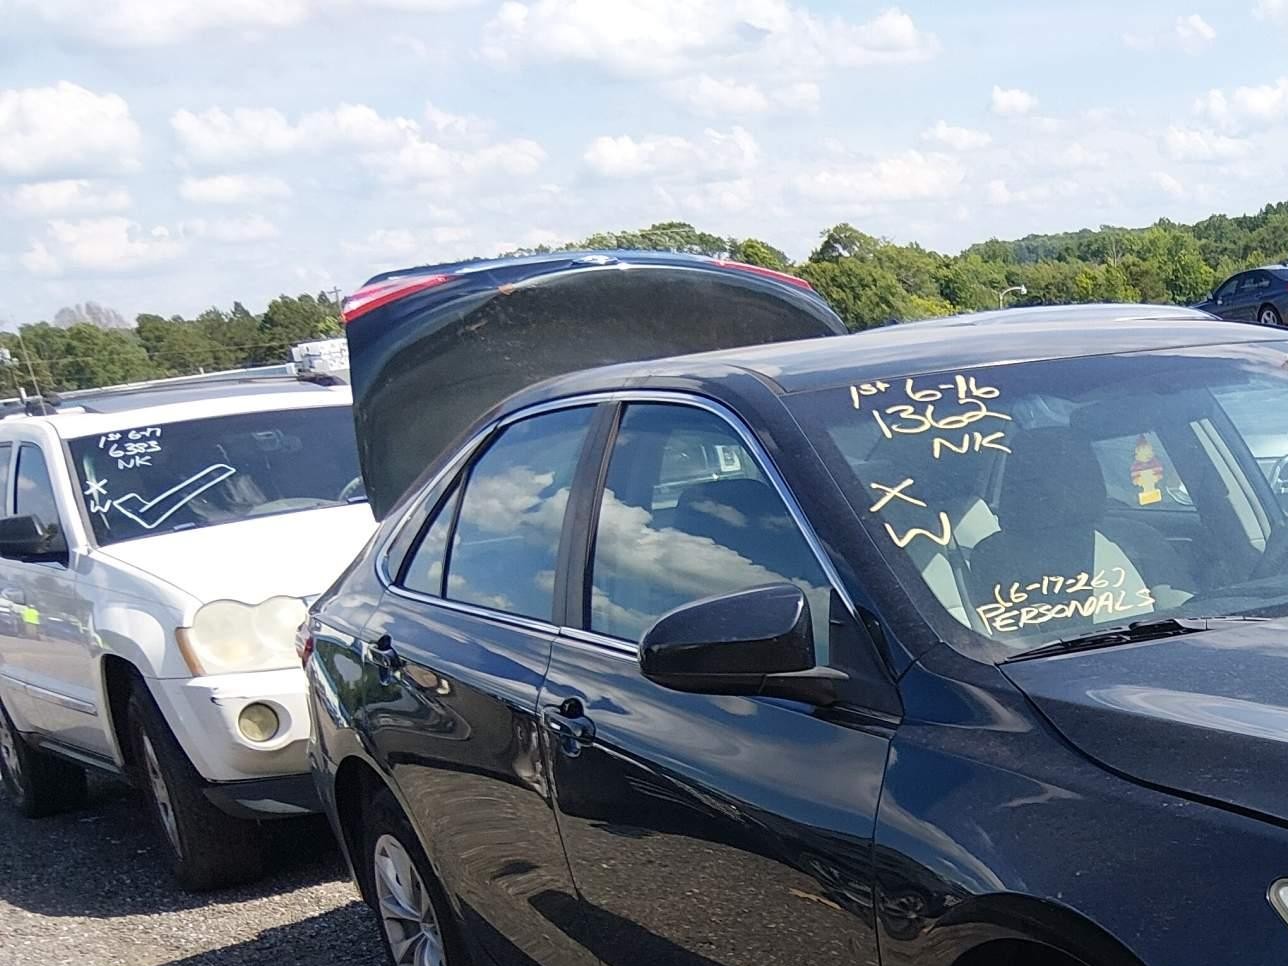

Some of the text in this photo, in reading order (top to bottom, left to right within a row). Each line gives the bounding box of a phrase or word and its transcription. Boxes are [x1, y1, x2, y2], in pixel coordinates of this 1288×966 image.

[906, 375, 1000, 401] 6-16
[872, 399, 1012, 439] 1362
[933, 432, 1012, 459] NK
[117, 455, 152, 470] NK
[90, 499, 112, 513] W
[869, 478, 927, 513] X
[884, 511, 952, 548] W
